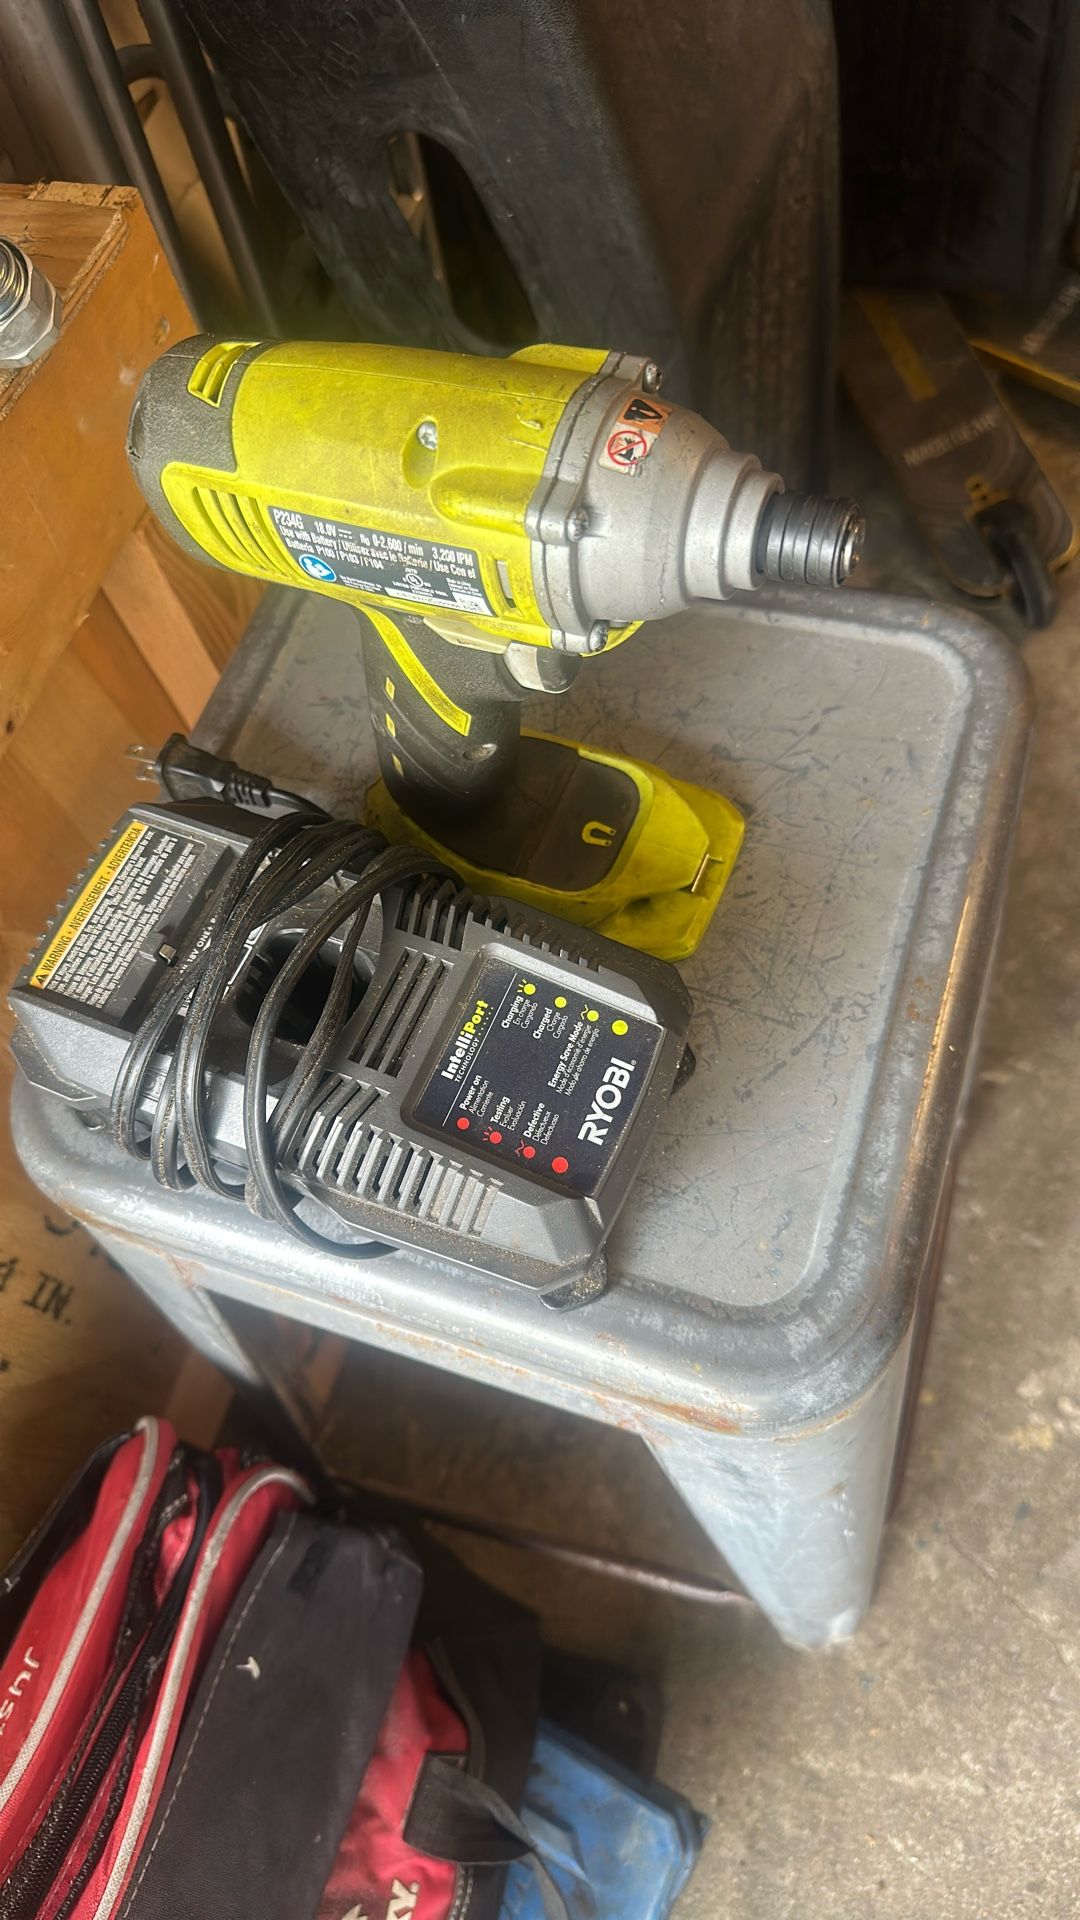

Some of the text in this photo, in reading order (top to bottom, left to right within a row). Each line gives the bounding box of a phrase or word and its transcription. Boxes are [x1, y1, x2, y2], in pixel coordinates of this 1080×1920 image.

[273, 508, 304, 530] P234G
[314, 520, 337, 537] 18.0V
[408, 543, 424, 556] min
[456, 551, 474, 567] IPM
[279, 525, 295, 538] Use
[294, 529, 311, 542] with
[310, 532, 337, 550] Battery
[370, 548, 389, 560] avec
[389, 551, 398, 562] le
[433, 561, 449, 573] Use
[450, 564, 466, 577] Con
[467, 568, 476, 579] el
[41, 935, 72, 972] WARNING
[69, 875, 110, 931] AVERTISSEMENT
[107, 828, 142, 872] ADVERTENCIA
[187, 948, 199, 962] 18V
[501, 995, 524, 1029] Charging
[520, 1002, 538, 1029] Cargando
[532, 1007, 553, 1039] Charged
[552, 1015, 569, 1039] Cargado
[441, 1000, 489, 1080] IntelliPort
[548, 1021, 584, 1088] Energy Save Mode
[454, 1037, 480, 1083] TECHNOLOGY
[459, 1074, 483, 1111] Power on
[490, 1096, 511, 1124] Testing
[577, 1056, 635, 1146] RYOBI
[523, 1102, 546, 1138] Defective
[540, 1113, 560, 1146] Defectuoso
